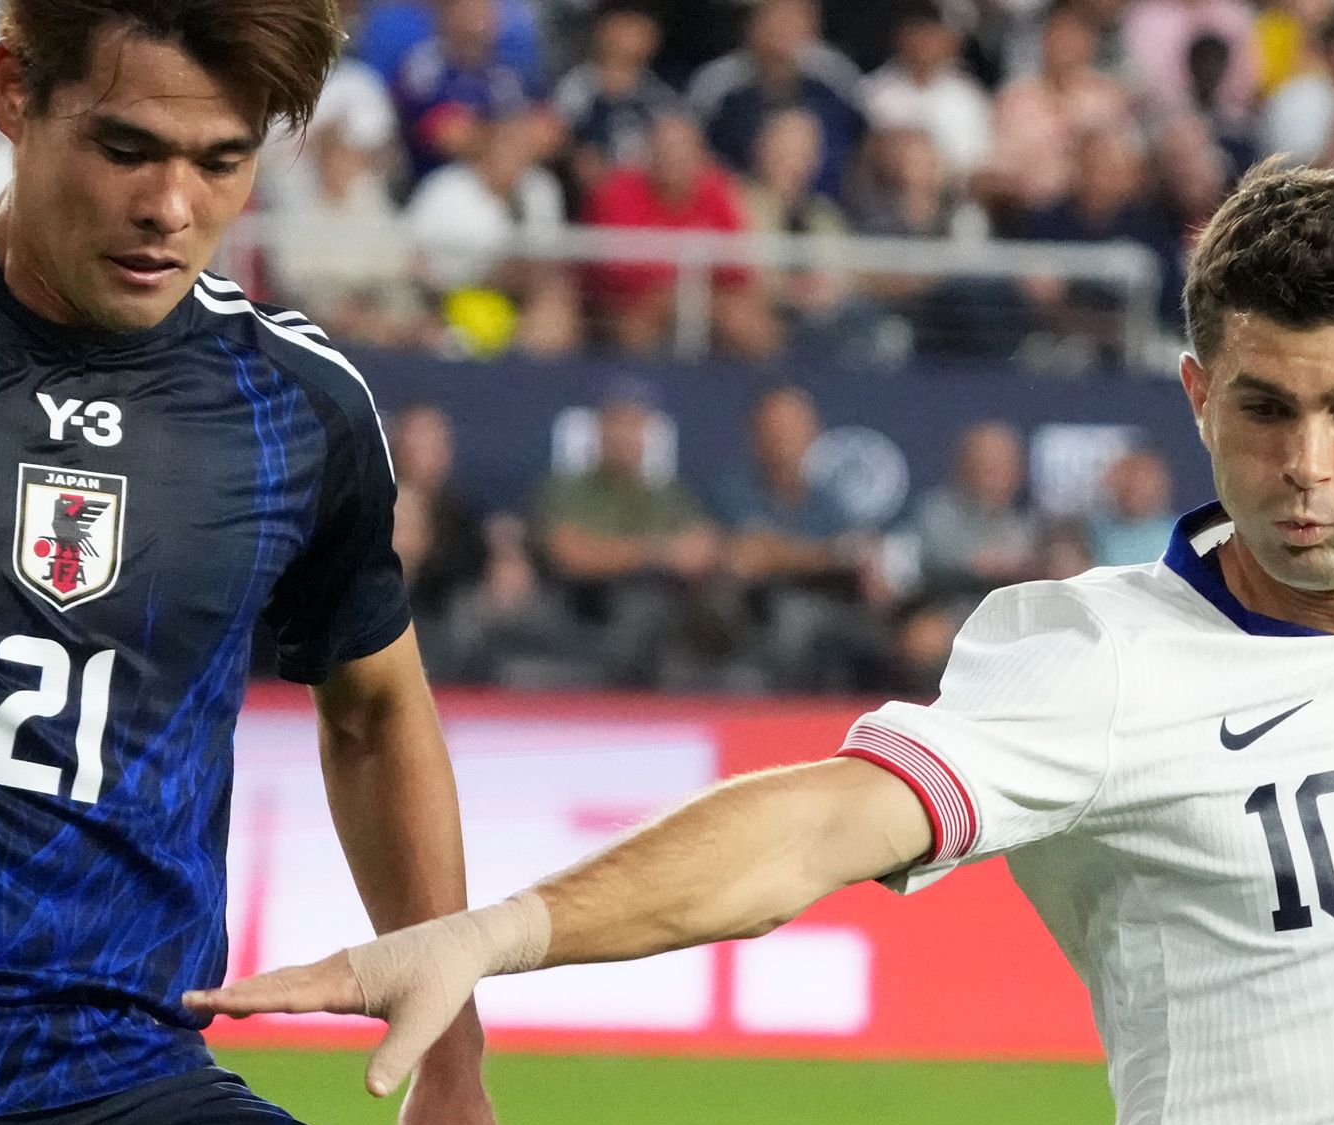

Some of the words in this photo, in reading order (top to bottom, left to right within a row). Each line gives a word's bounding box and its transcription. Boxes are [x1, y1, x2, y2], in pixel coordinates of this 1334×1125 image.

[35, 391, 123, 447] Y-3
[45, 472, 100, 490] JAPAN
[41, 561, 87, 586] JFA
